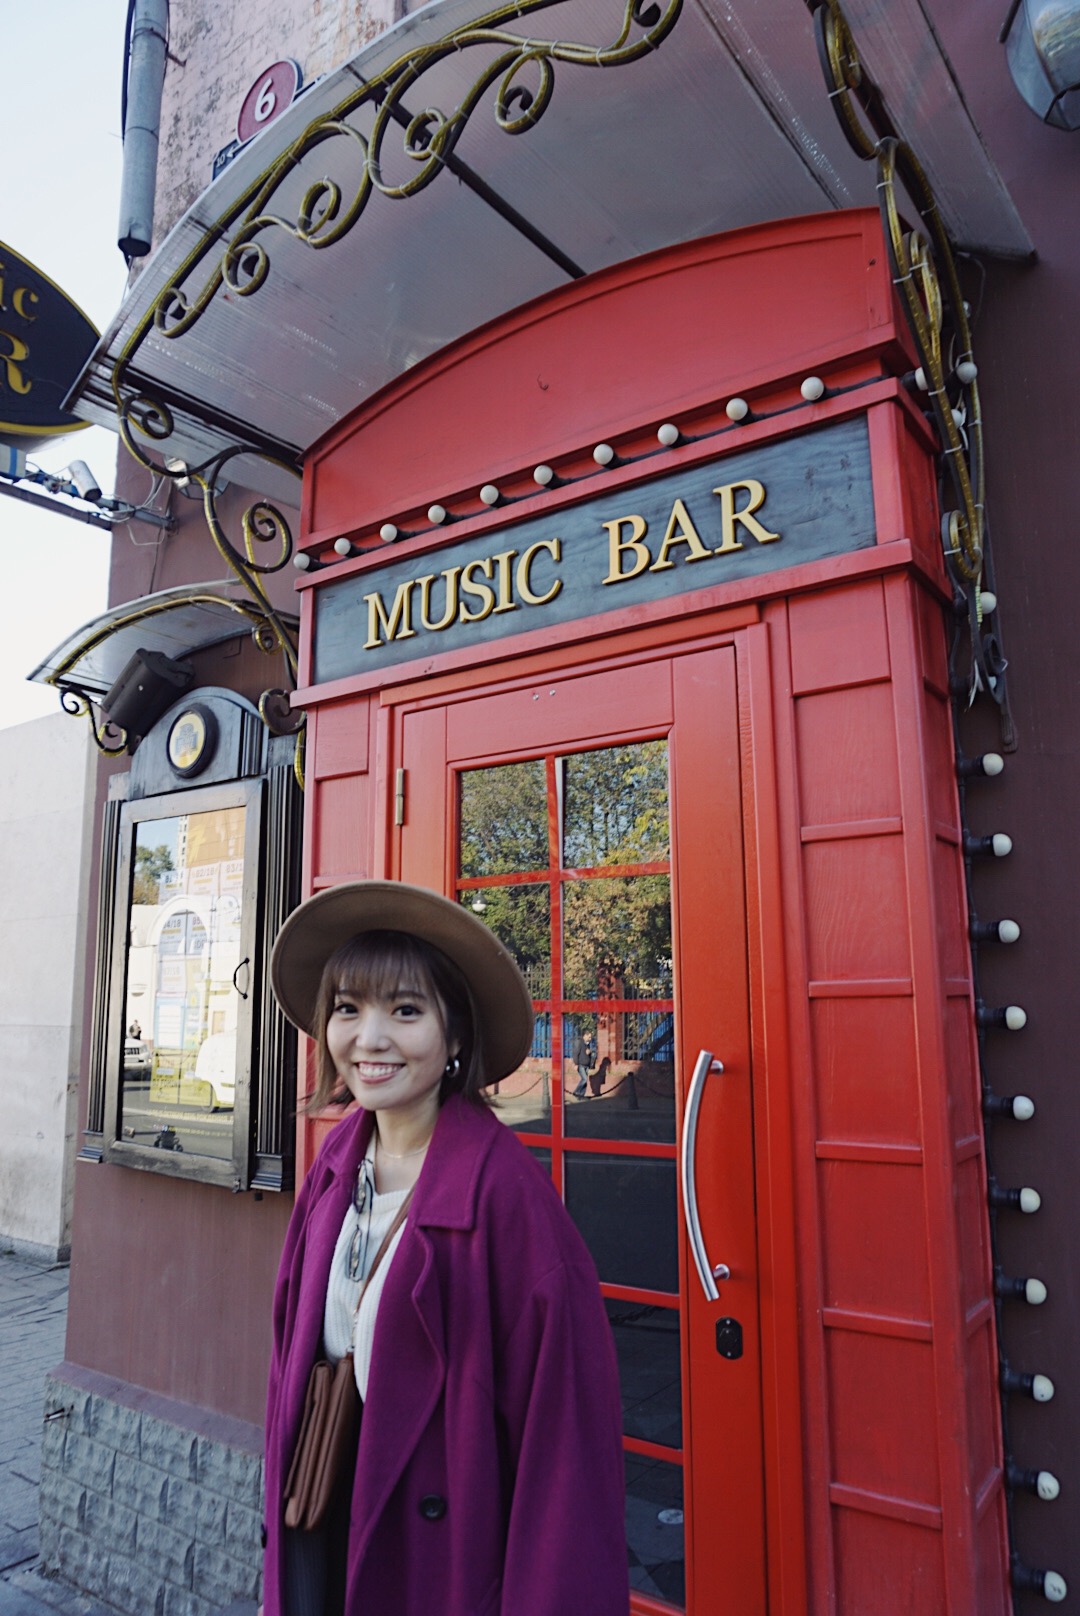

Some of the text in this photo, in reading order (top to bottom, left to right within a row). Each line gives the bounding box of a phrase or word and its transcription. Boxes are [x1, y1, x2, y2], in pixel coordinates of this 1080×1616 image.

[254, 78, 276, 122] 6
[362, 478, 781, 650] MUSIC BAR
